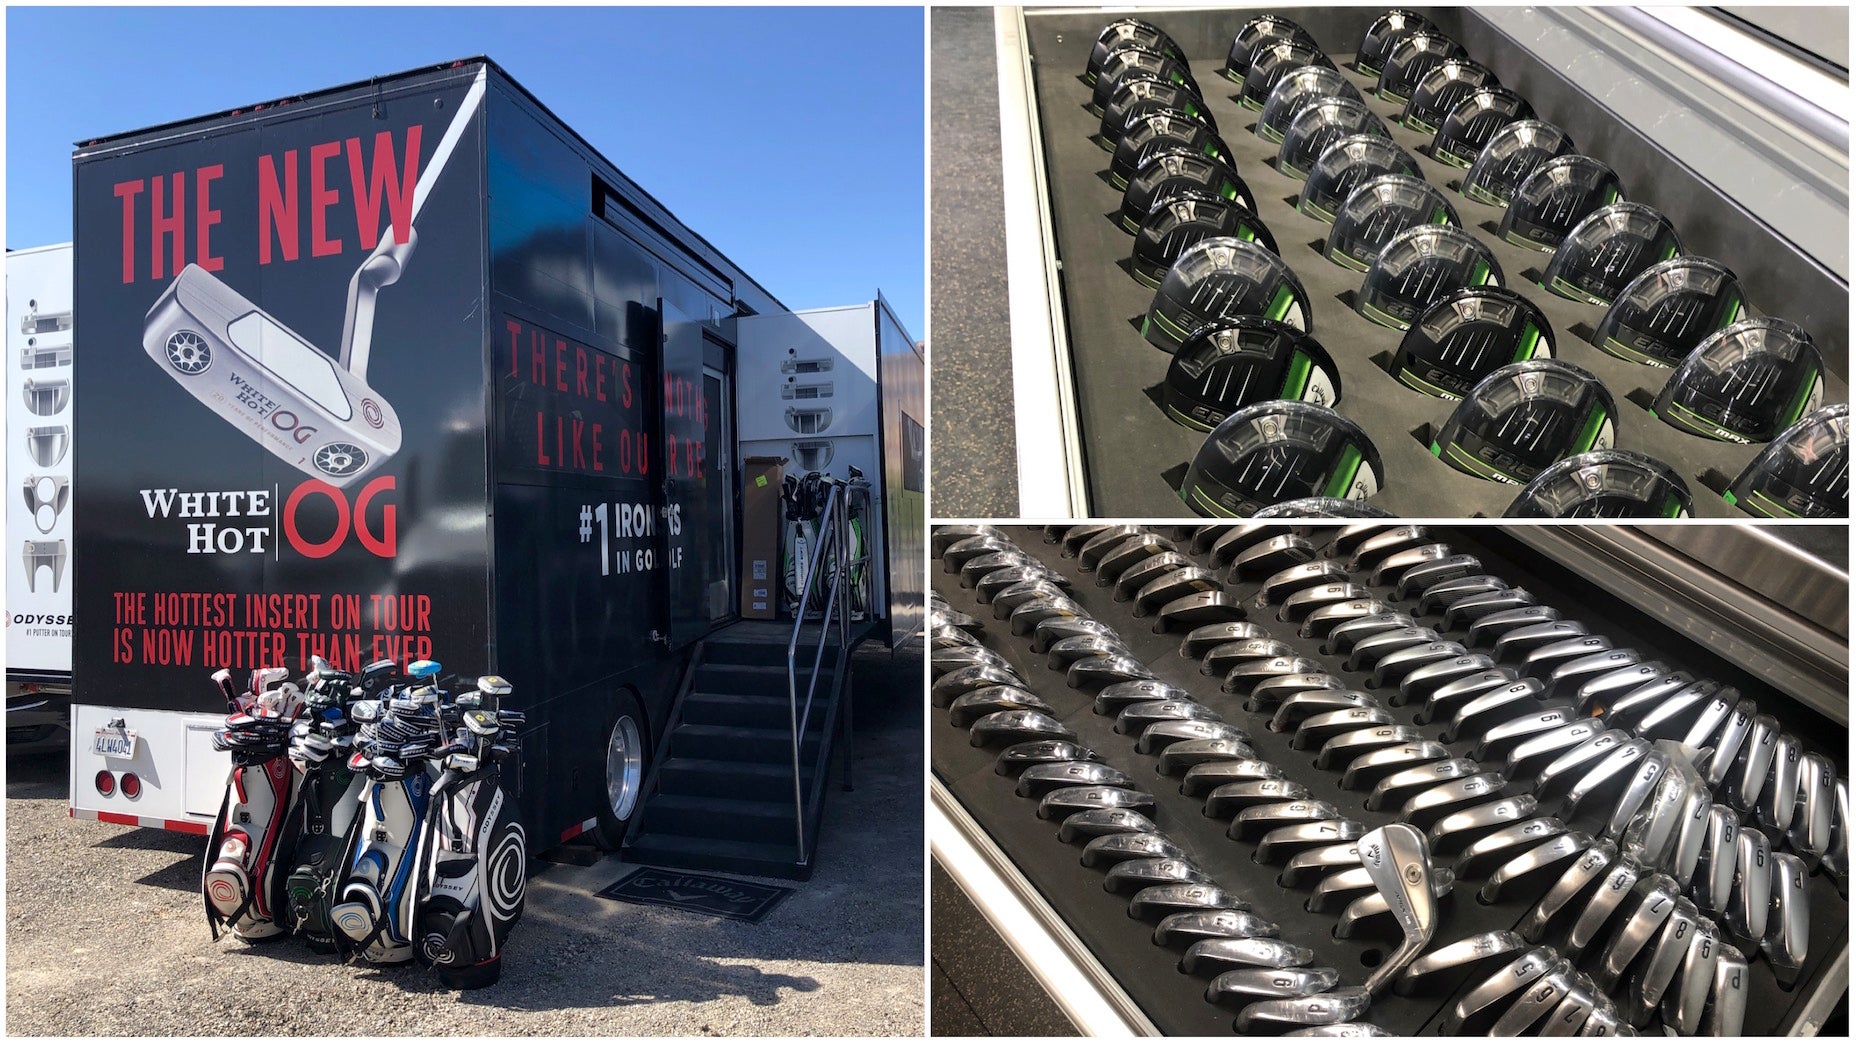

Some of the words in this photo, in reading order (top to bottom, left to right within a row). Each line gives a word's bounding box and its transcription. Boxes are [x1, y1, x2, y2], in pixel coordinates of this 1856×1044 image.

[114, 164, 224, 284] THE
[258, 125, 422, 265] NEW
[506, 320, 633, 409] THERE'S
[230, 372, 276, 409] WHITE
[236, 391, 268, 416] HOT
[271, 410, 318, 444] OG
[537, 411, 603, 471] LIKE
[1715, 428, 1751, 445] MAX
[140, 489, 270, 519] WHITE
[283, 475, 396, 559] OG
[186, 523, 269, 555] HOT
[579, 502, 610, 577] #1
[616, 551, 630, 574] IN
[1327, 586, 1342, 594] 9
[113, 591, 146, 625] THE
[154, 592, 237, 628] HOTTEST
[245, 593, 321, 630] INSERT
[331, 593, 360, 631] ON
[370, 594, 431, 632] TOUR
[1429, 644, 1446, 652] 5
[1583, 638, 1600, 646] 8
[113, 628, 133, 664] IS
[143, 628, 194, 666] NOW
[203, 631, 286, 669] HOTTER
[296, 632, 360, 674] THAN
[1609, 652, 1626, 660] 9
[1484, 673, 1501, 681] 7
[1664, 674, 1681, 685] 3
[1509, 684, 1526, 693] 8
[1343, 694, 1361, 702] 4
[1714, 697, 1729, 711] 5
[1351, 711, 1368, 719] 5
[1540, 713, 1557, 722] 9
[1736, 713, 1748, 726] 6
[1376, 729, 1393, 737] 6
[1571, 728, 1589, 737] P
[1761, 729, 1771, 746] 7
[1594, 737, 1612, 747] 3
[1620, 746, 1636, 759] 4
[1787, 746, 1797, 763] 8
[1436, 765, 1453, 774] 8
[1643, 764, 1659, 783] 5
[1261, 783, 1278, 791] 5
[1464, 782, 1480, 792] 9
[1088, 792, 1103, 800] P
[481, 794, 501, 834] ODYSSEY
[1694, 802, 1705, 820] 7
[1320, 826, 1337, 835] 7
[1523, 824, 1542, 834] 3
[1724, 825, 1733, 843] 8
[1583, 854, 1602, 871] 5
[1756, 849, 1764, 868] 9
[1612, 873, 1627, 891] 6
[1794, 871, 1805, 889] P
[633, 876, 756, 903] Callaway
[1650, 898, 1667, 914] 7
[1675, 921, 1687, 940] 8
[1701, 940, 1712, 960] 9
[1515, 957, 1535, 978] 5
[1273, 978, 1293, 988] 9
[1731, 968, 1742, 990] P
[1536, 986, 1555, 1003] 6
[1308, 1003, 1329, 1015] P
[1564, 1006, 1582, 1024] 7
